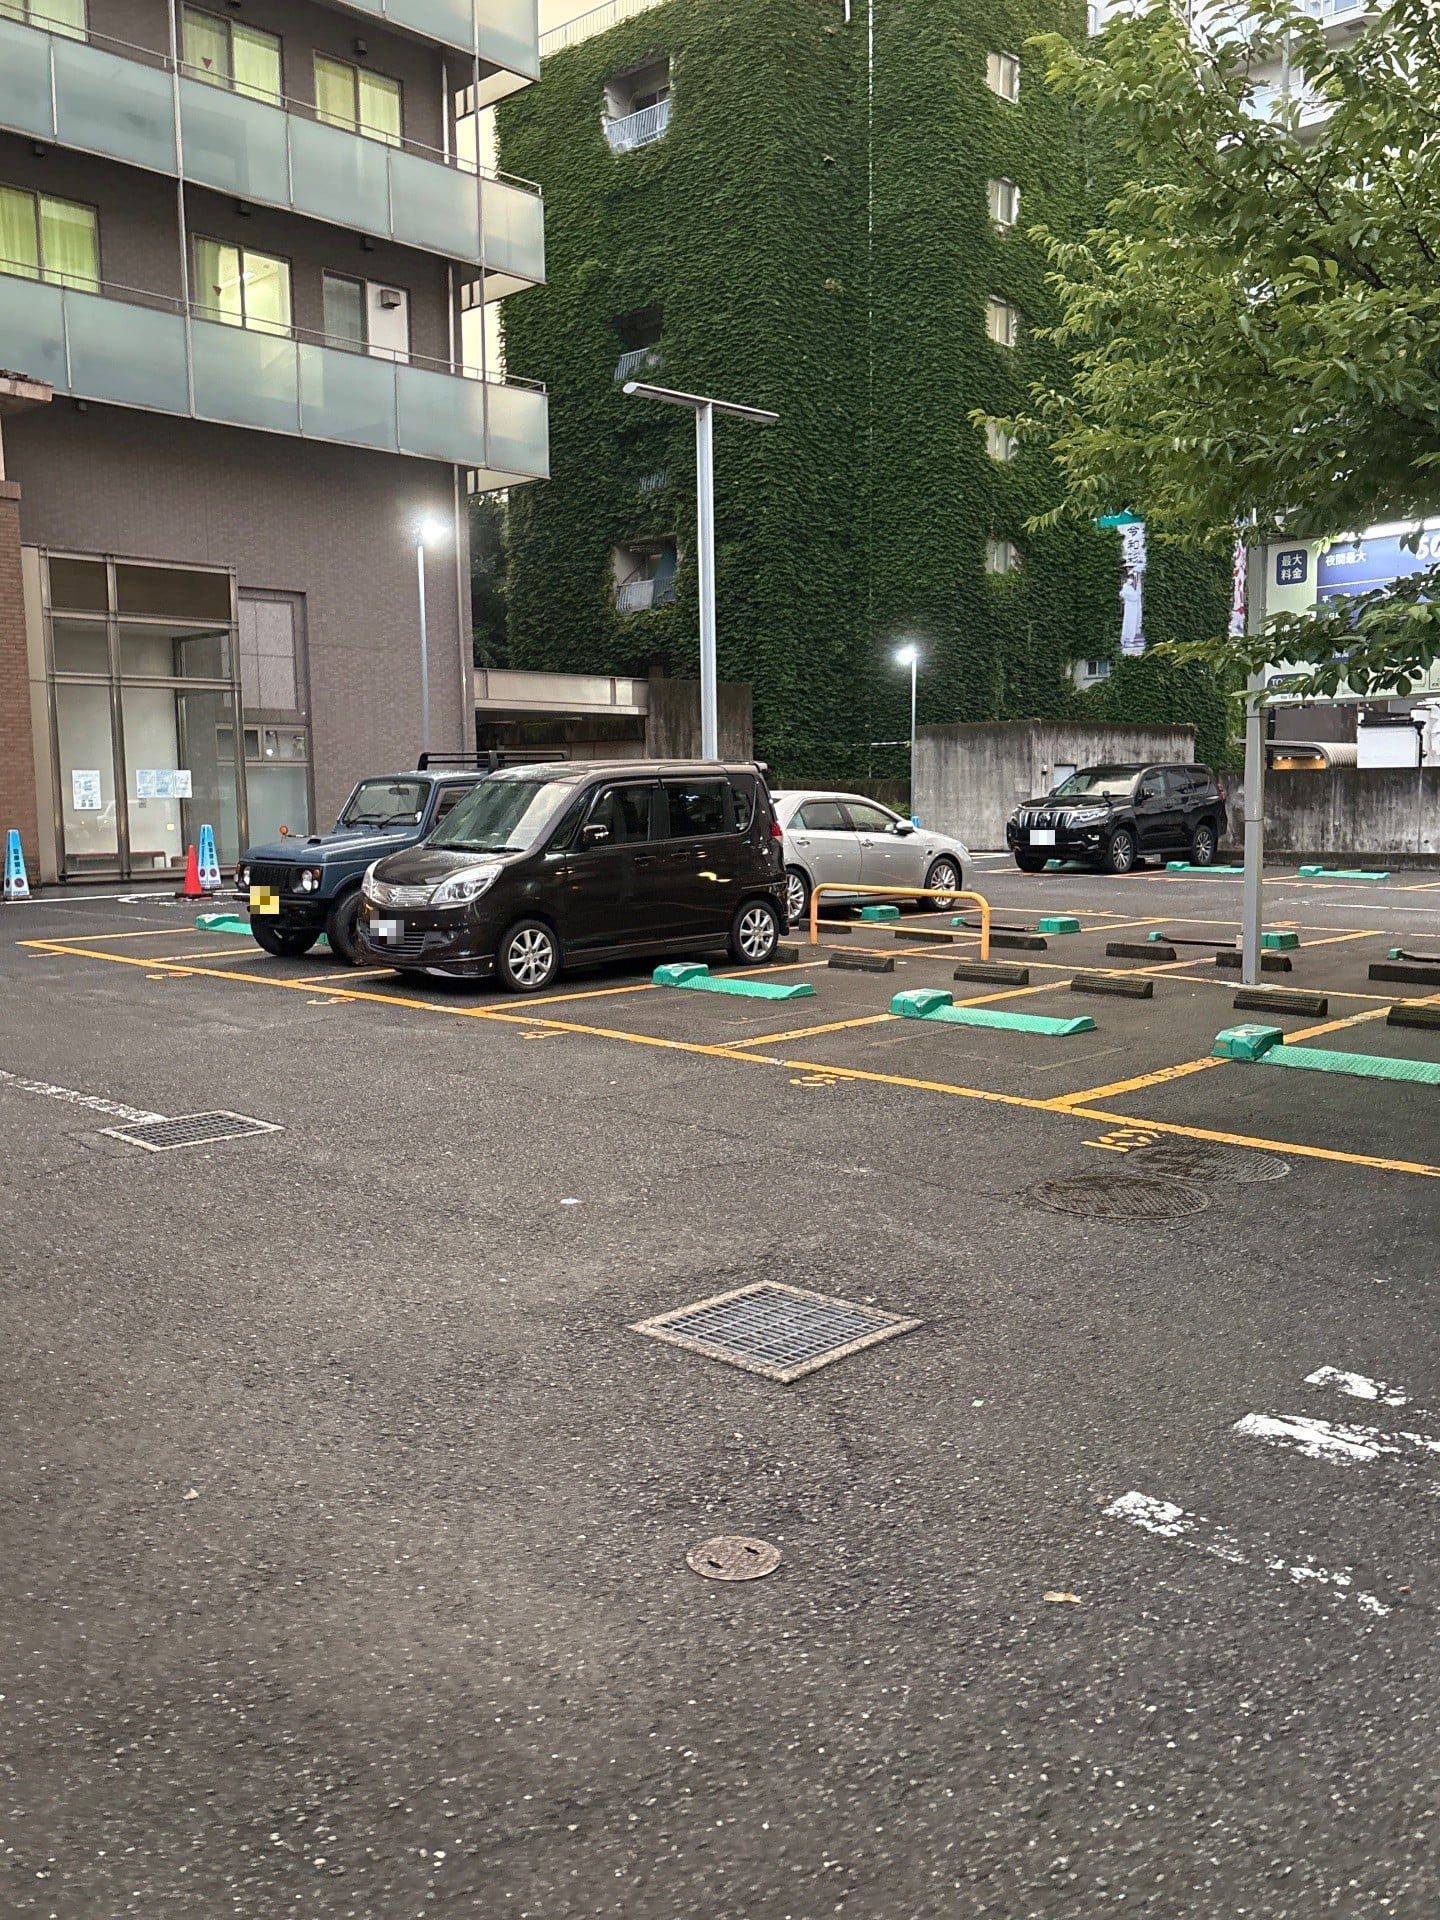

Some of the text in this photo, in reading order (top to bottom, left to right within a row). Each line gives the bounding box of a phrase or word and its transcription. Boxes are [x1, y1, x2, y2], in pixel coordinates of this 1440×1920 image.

[1281, 554, 1303, 567] 最大
[1325, 551, 1367, 567] 夜間最大
[1281, 567, 1303, 581] 料金
